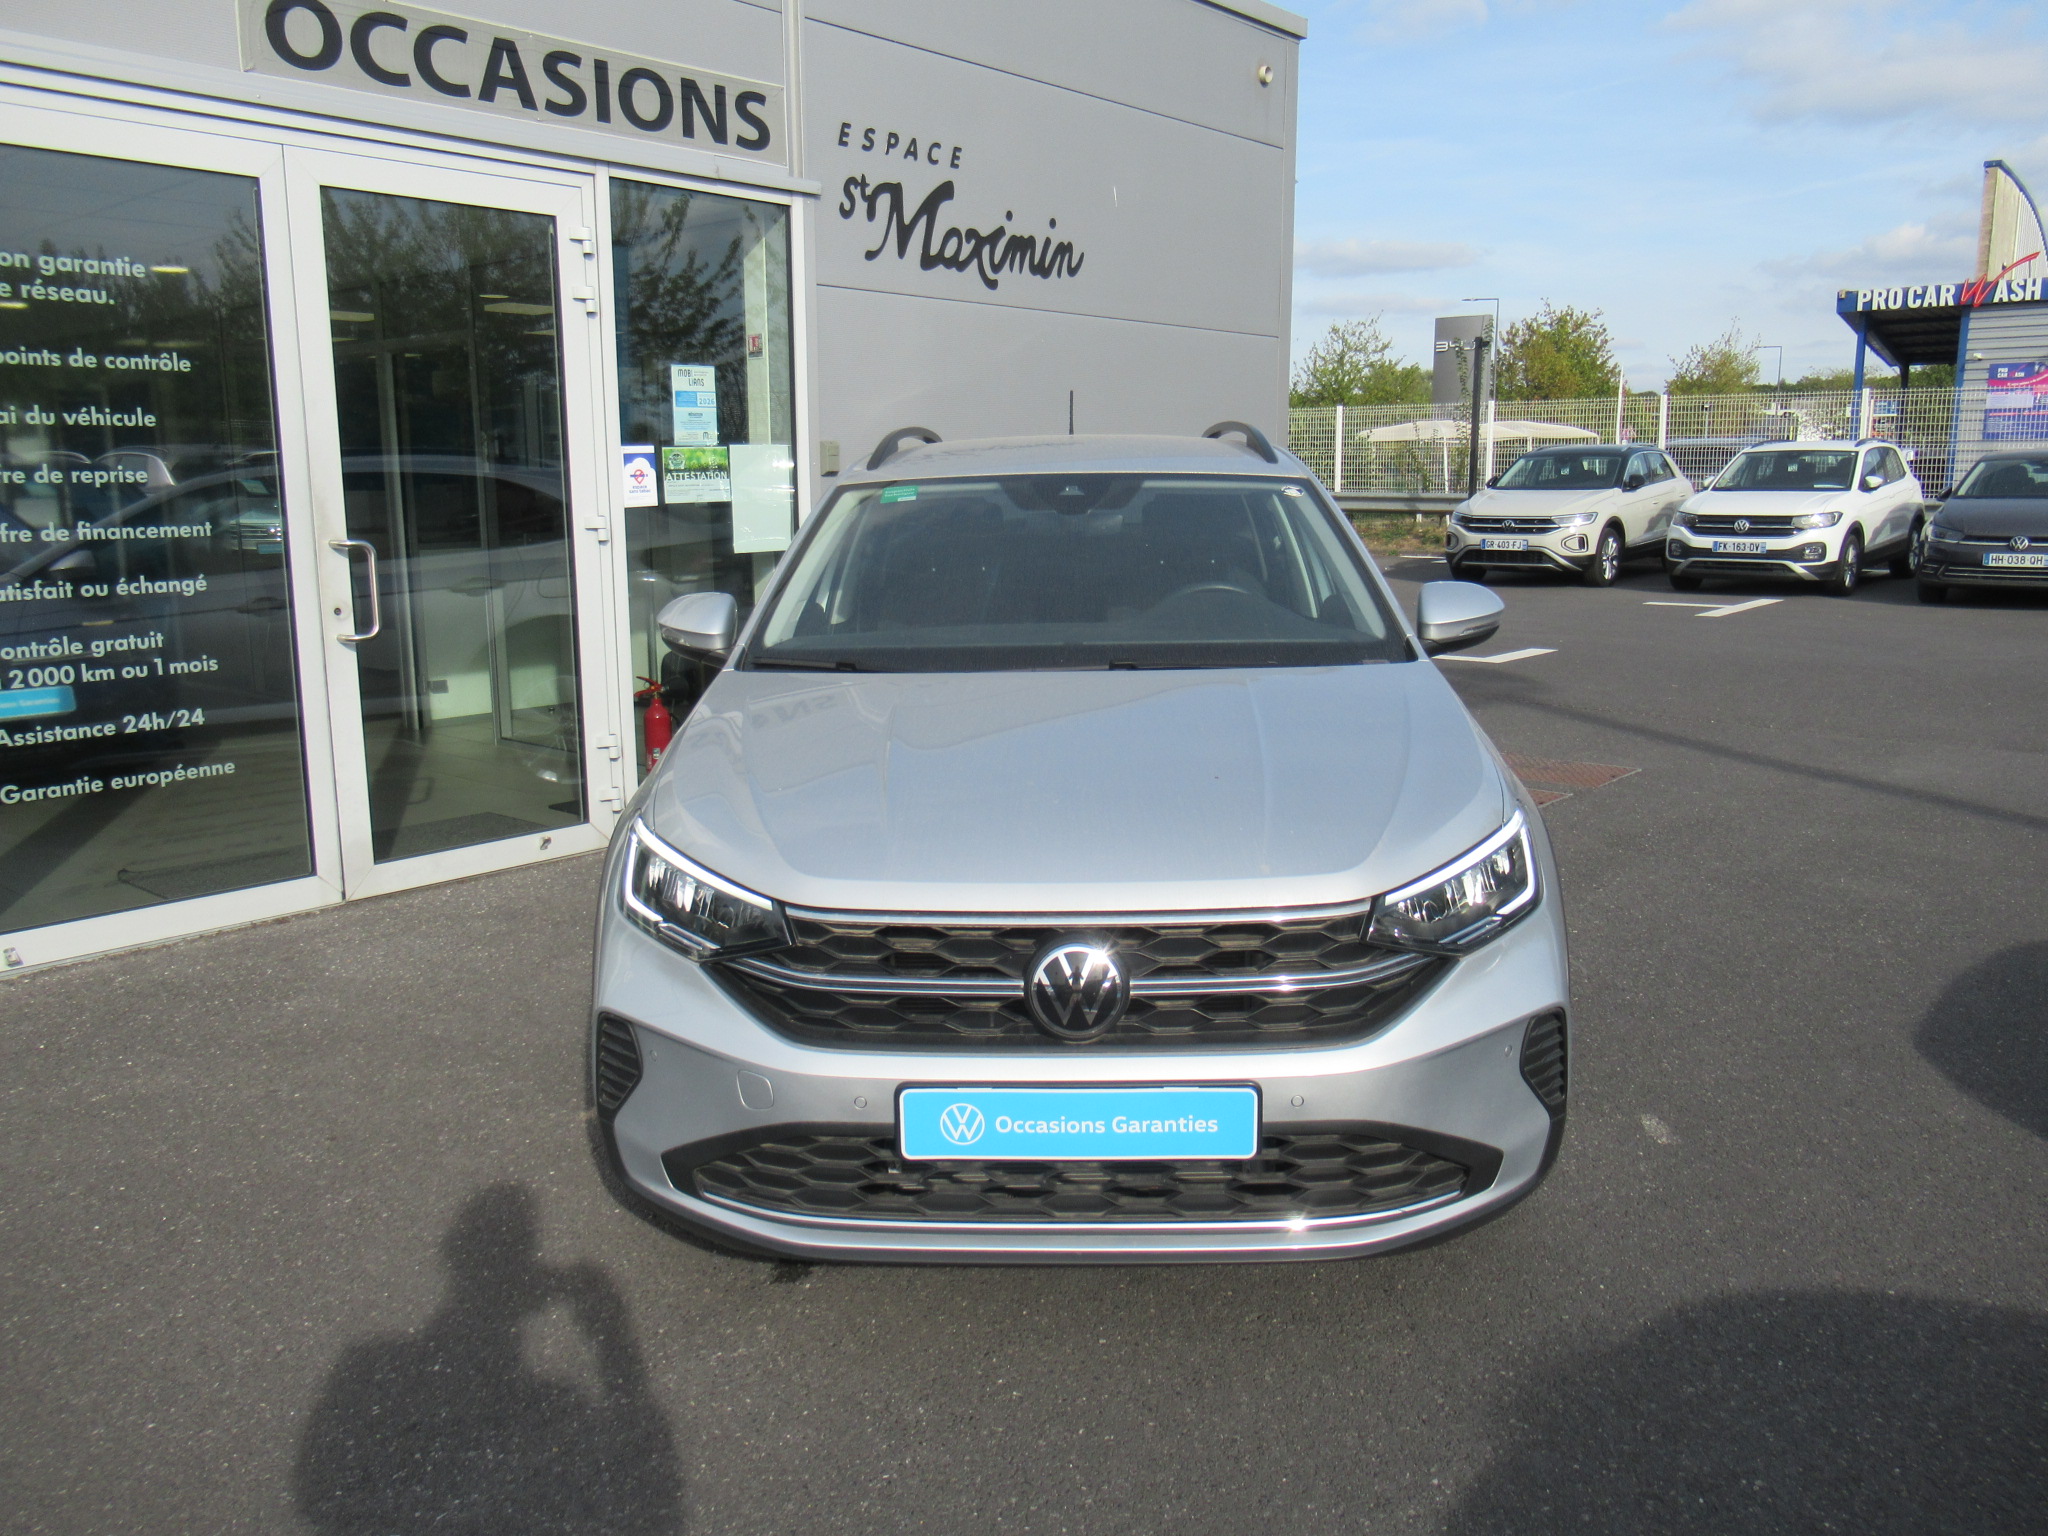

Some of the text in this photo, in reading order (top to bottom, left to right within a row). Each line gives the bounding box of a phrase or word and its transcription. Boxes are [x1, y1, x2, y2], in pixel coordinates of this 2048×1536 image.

[265, 0, 771, 151] OCCASIONS
[838, 122, 962, 169] ESPACE
[865, 181, 1084, 290] Maximin
[38, 256, 146, 278] garantie
[20, 278, 115, 305] réseau.
[1857, 258, 2041, 311] PRO CAR WASH
[0, 346, 191, 372] oints de contrôle
[25, 405, 55, 425] du
[63, 407, 156, 427] véhicule
[0, 464, 148, 488] re de reprise
[666, 471, 728, 481] ATTESTATION
[40, 522, 70, 542] de
[77, 521, 212, 541] financement
[80, 583, 108, 598] ou
[116, 573, 207, 596] échangé
[91, 631, 164, 657] gratuit
[81, 664, 115, 683] km
[122, 664, 148, 679] ou
[154, 658, 163, 676] 1
[170, 655, 218, 675] mois
[0, 708, 205, 747] Assistance 24h/24
[1, 762, 235, 804] Garantie européenne
[995, 1115, 1105, 1134] Occasions
[1112, 1114, 1218, 1134] Garanties
